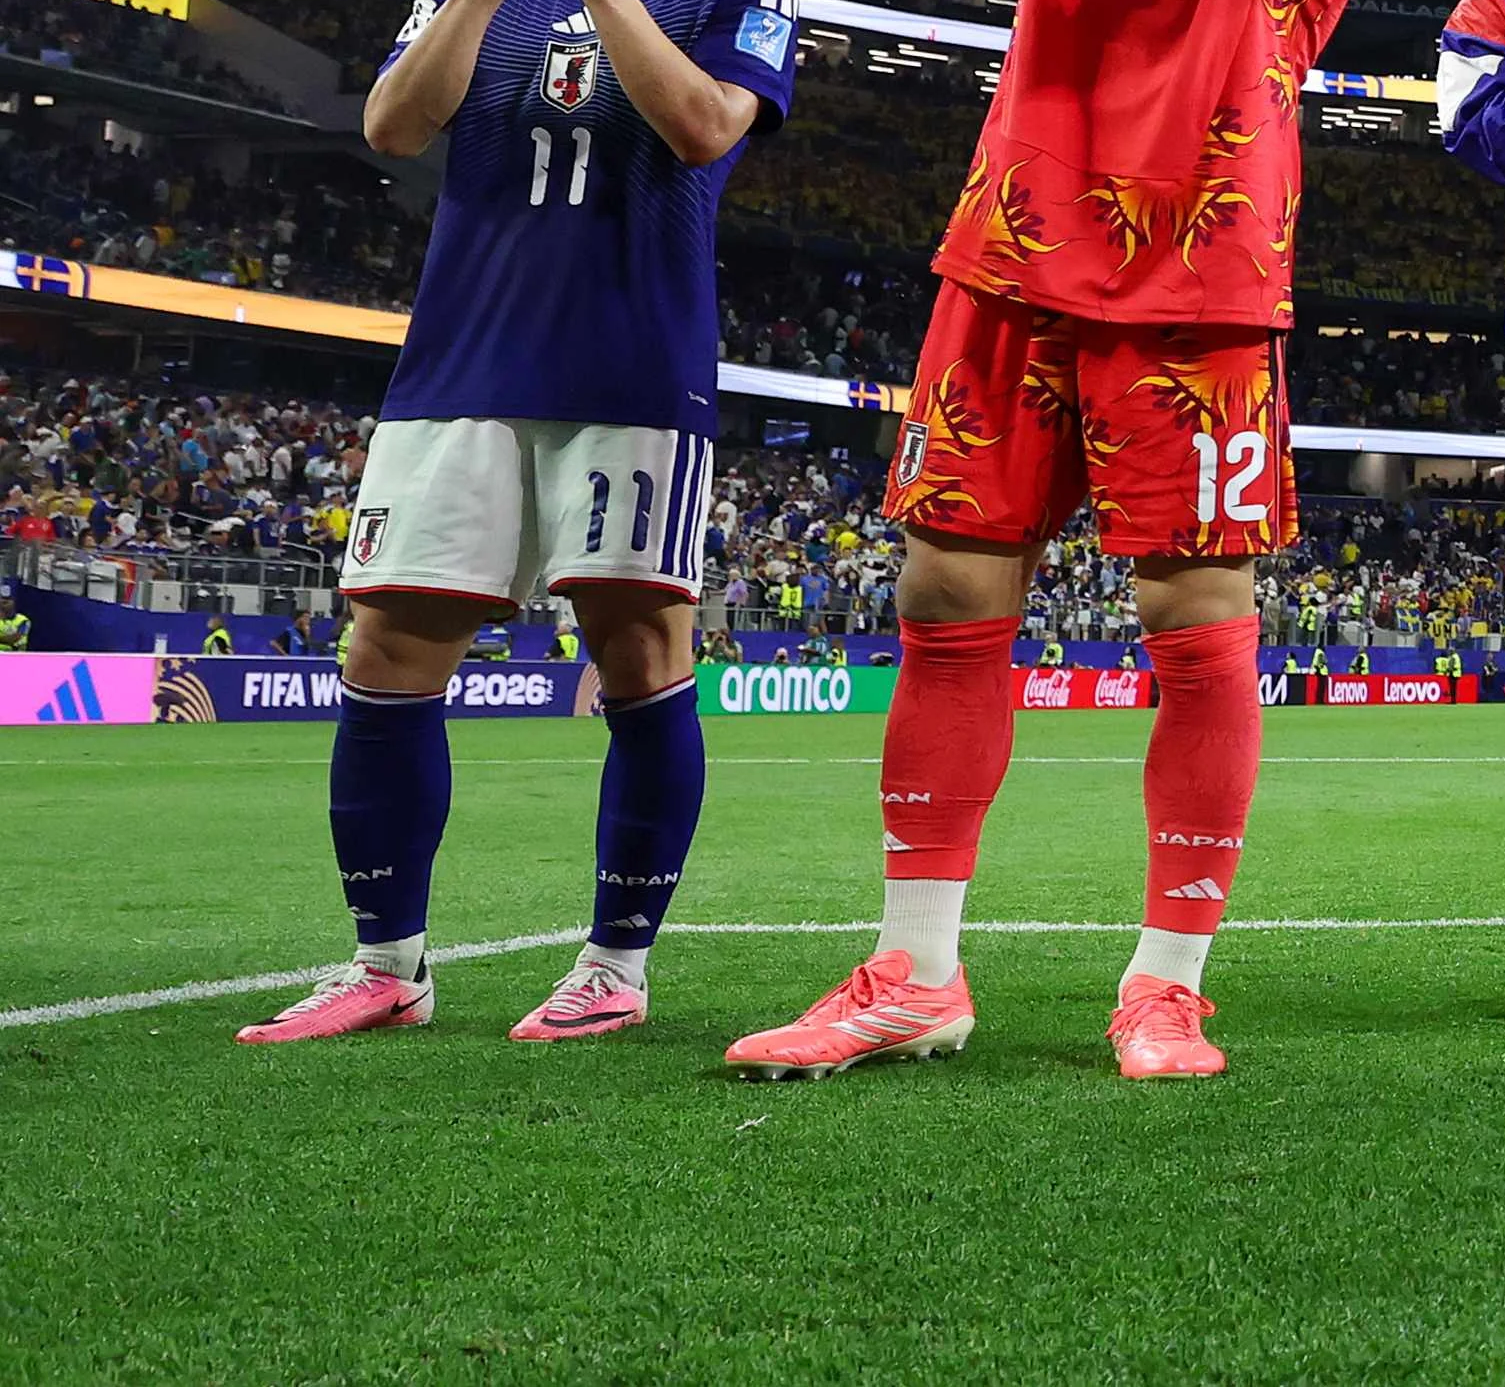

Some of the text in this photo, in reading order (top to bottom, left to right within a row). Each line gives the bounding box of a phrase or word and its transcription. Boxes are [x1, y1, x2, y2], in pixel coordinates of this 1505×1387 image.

[530, 127, 591, 205] 11
[1192, 431, 1268, 523] 12
[588, 470, 652, 552] 11
[243, 672, 306, 707] FIFA
[464, 674, 546, 705] 2026
[720, 666, 851, 712] aramco
[1328, 677, 1367, 703] Lenovo
[1384, 677, 1441, 703] Lenovo
[600, 870, 679, 887] JAPAN
